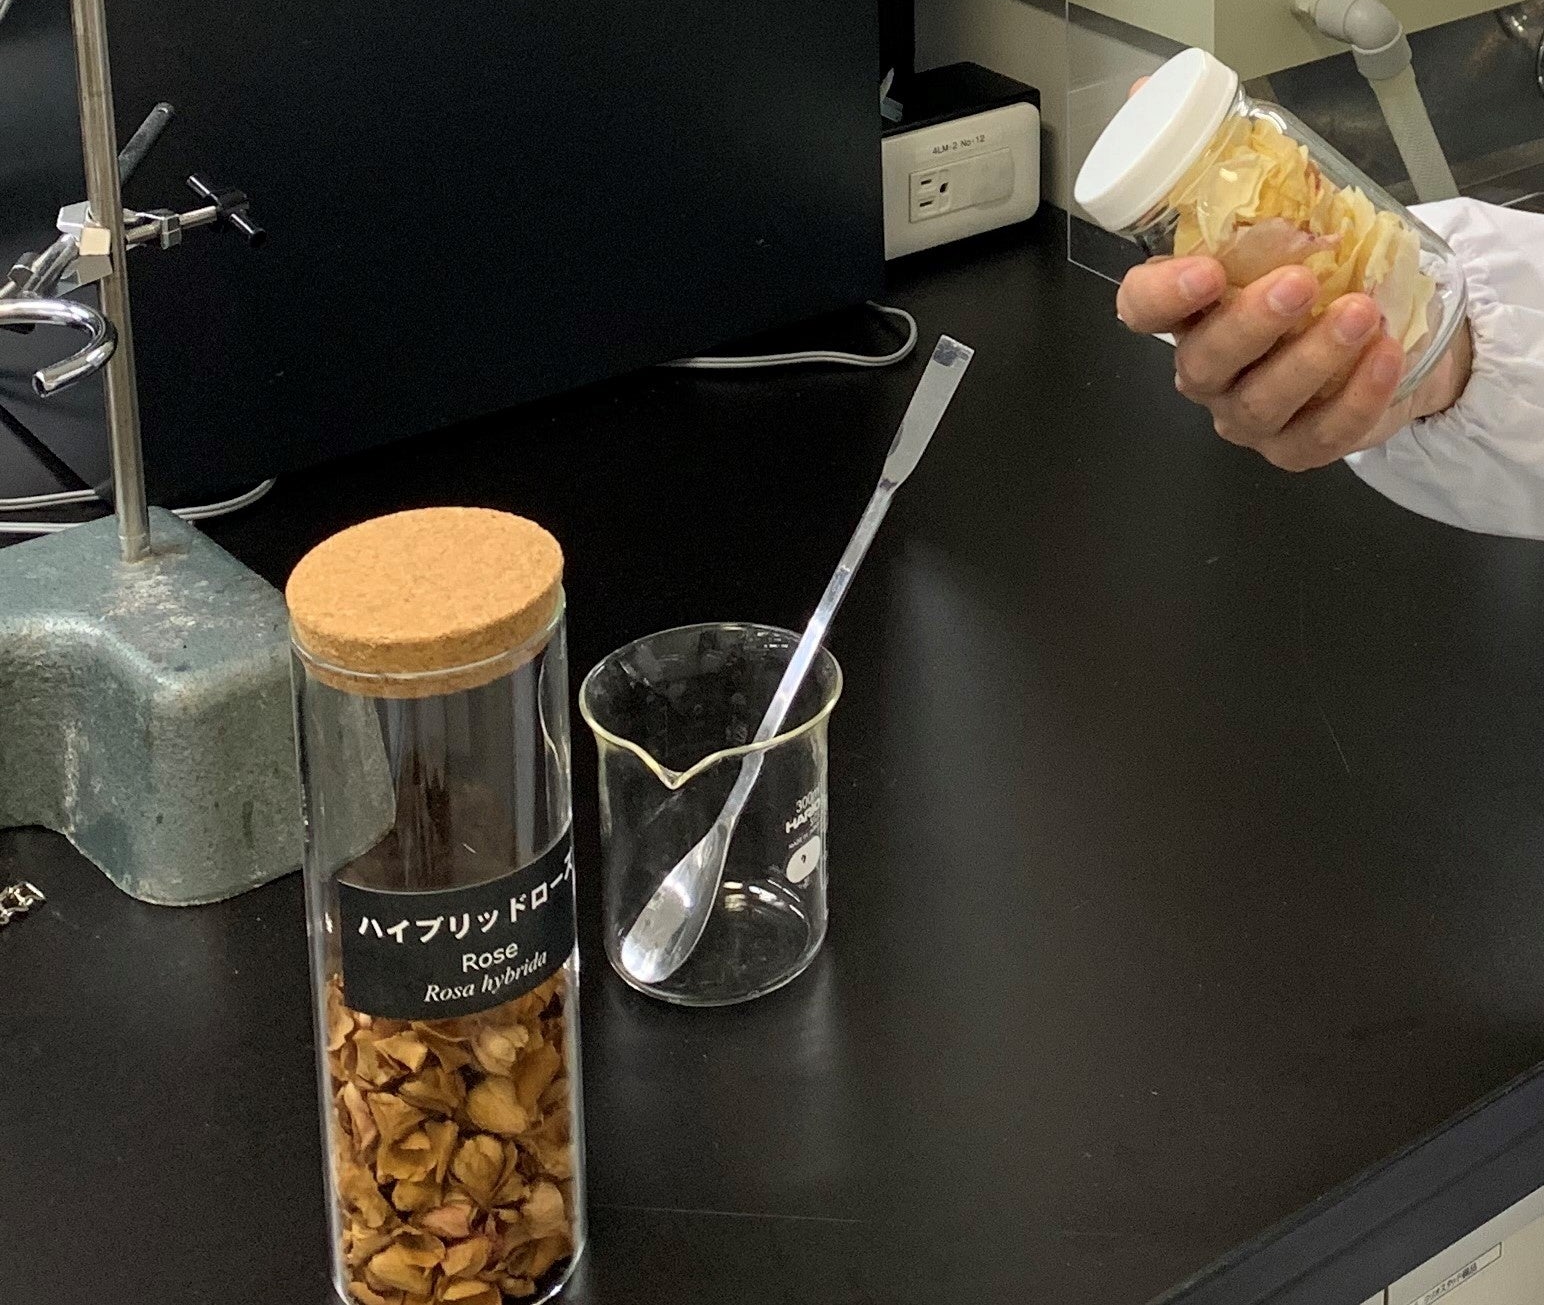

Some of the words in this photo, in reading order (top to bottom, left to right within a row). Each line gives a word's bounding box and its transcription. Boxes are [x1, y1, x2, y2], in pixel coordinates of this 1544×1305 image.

[423, 983, 475, 1003] Rosa
[481, 950, 548, 996] hybrida
[461, 942, 519, 973] Rose
